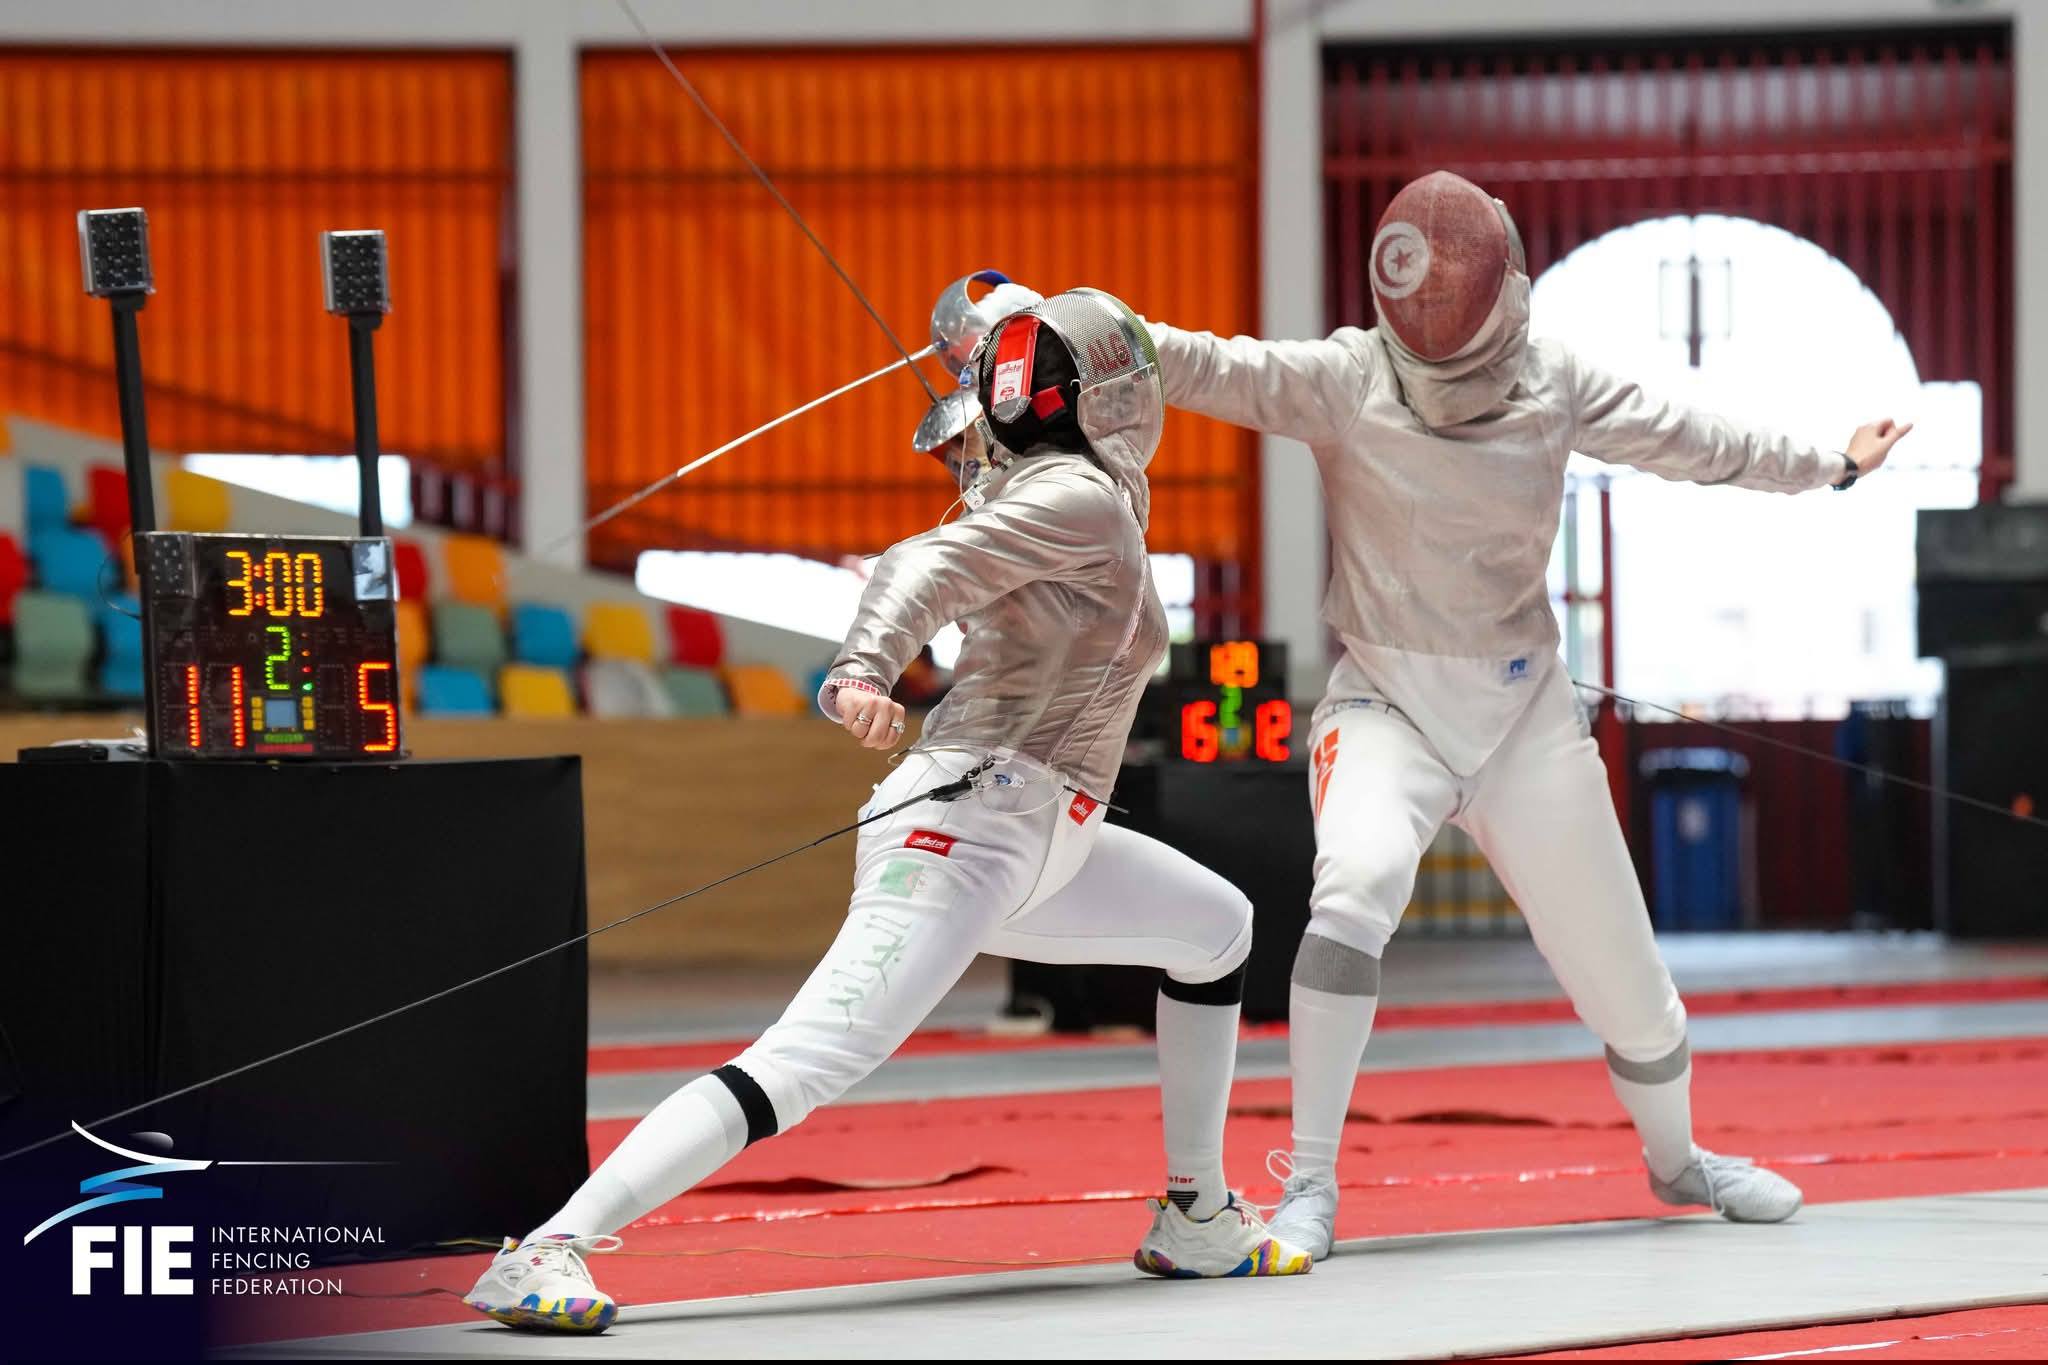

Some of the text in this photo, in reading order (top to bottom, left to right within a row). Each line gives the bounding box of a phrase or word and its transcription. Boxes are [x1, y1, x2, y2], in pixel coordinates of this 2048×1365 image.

[1087, 332, 1131, 374] ALG
[226, 551, 323, 617] 3:00
[264, 625, 291, 690] 2
[186, 664, 245, 748] 11
[358, 662, 396, 752] 5
[909, 835, 949, 850] allstar
